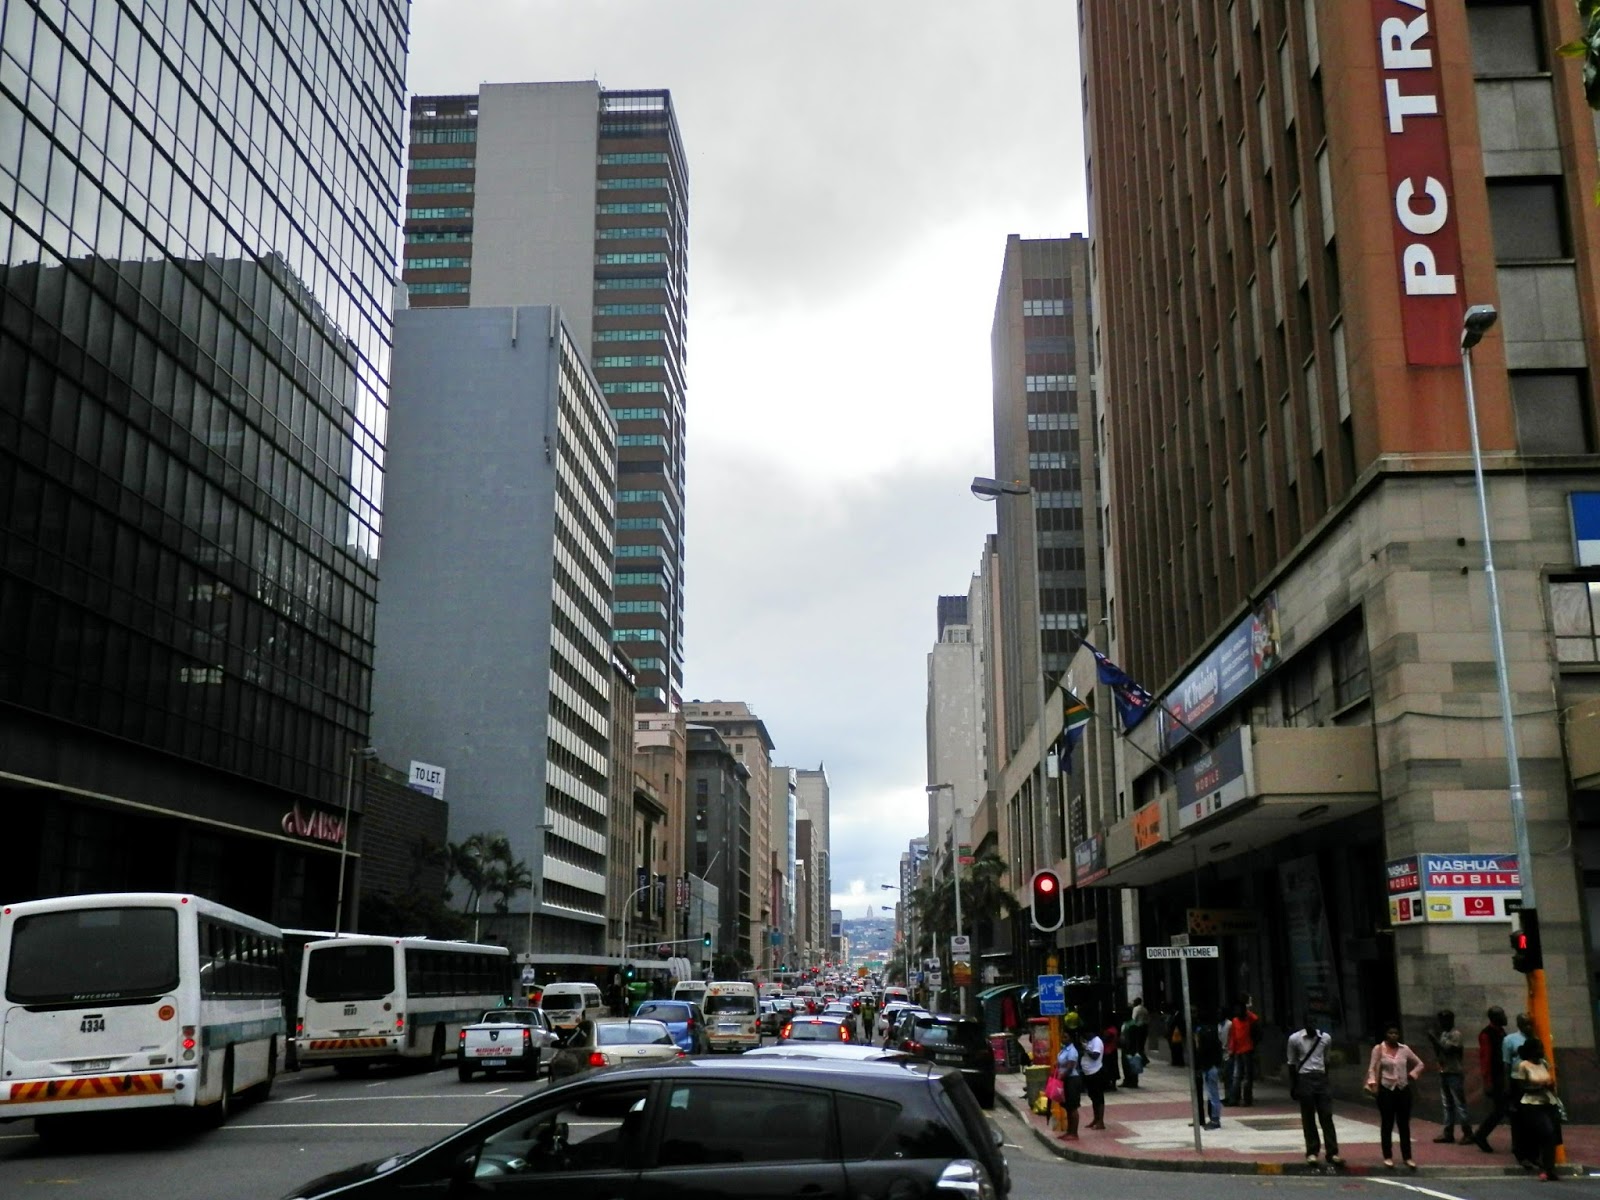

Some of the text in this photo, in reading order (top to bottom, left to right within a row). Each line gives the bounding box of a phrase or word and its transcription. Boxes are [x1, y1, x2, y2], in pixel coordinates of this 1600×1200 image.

[1379, 0, 1457, 295] PC TR
[415, 767, 425, 780] TO
[1429, 860, 1499, 871] NASHUA
[1390, 875, 1418, 888] MOBILE
[1432, 874, 1520, 885] MOBILE
[1148, 948, 1181, 957] DOROTHY
[1183, 947, 1211, 957] NYEMBE
[80, 1019, 105, 1033] 4334
